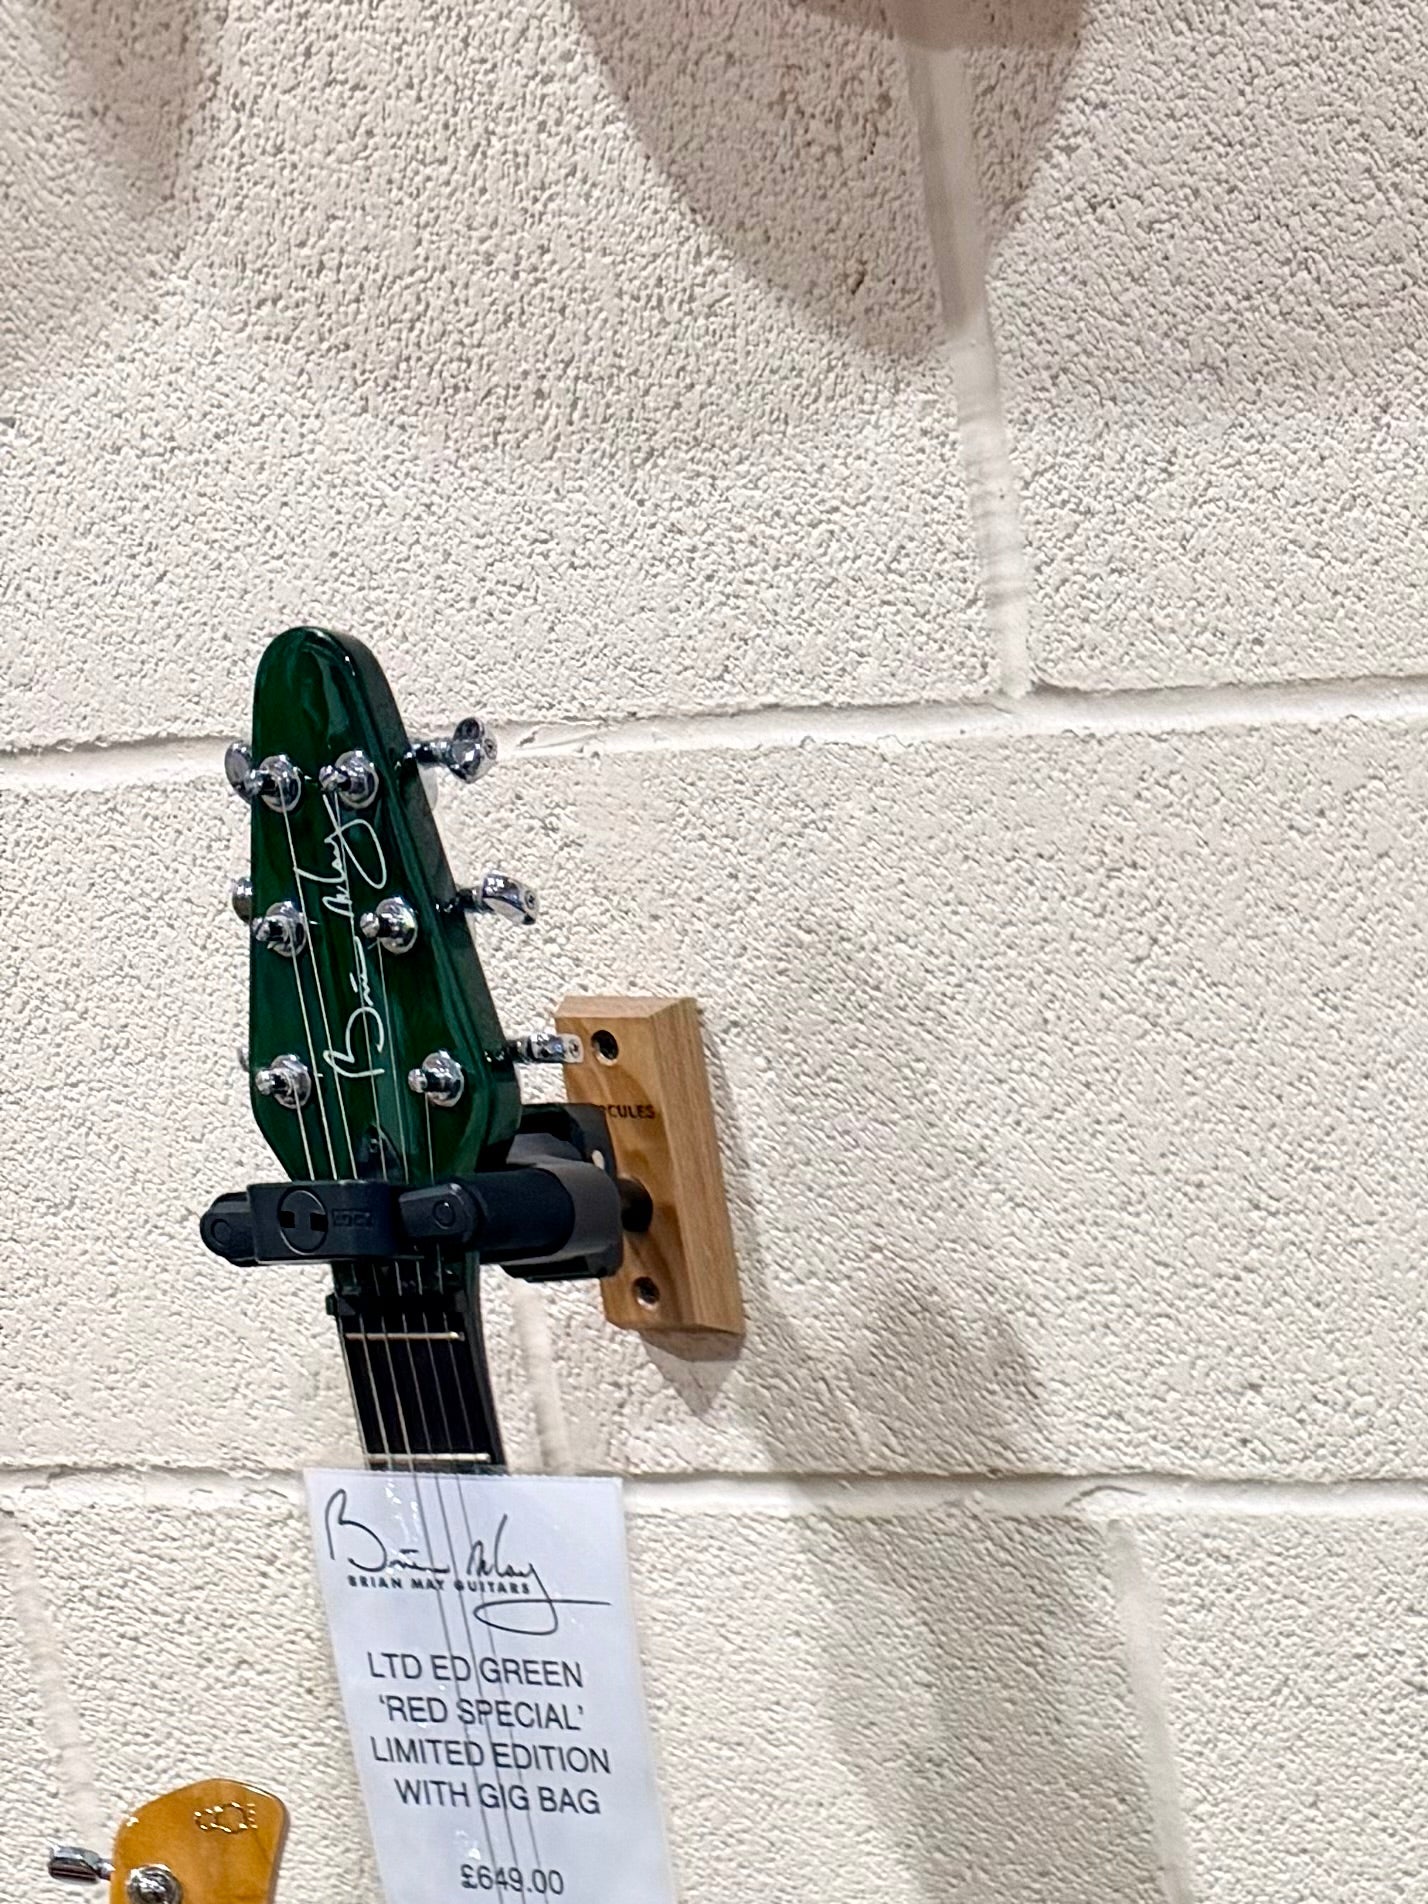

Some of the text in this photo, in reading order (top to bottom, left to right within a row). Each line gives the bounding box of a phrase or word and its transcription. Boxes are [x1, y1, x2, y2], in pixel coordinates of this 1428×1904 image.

[600, 1103, 656, 1120] CULES
[347, 1575, 531, 1595] BRIAN MAY GUITARS
[368, 1653, 584, 1688] LTD ED GREEN
[370, 1737, 611, 1773] LIMITED EDITION
[395, 1779, 601, 1814] WITH GIG BAG
[459, 1864, 565, 1897] £649.00
